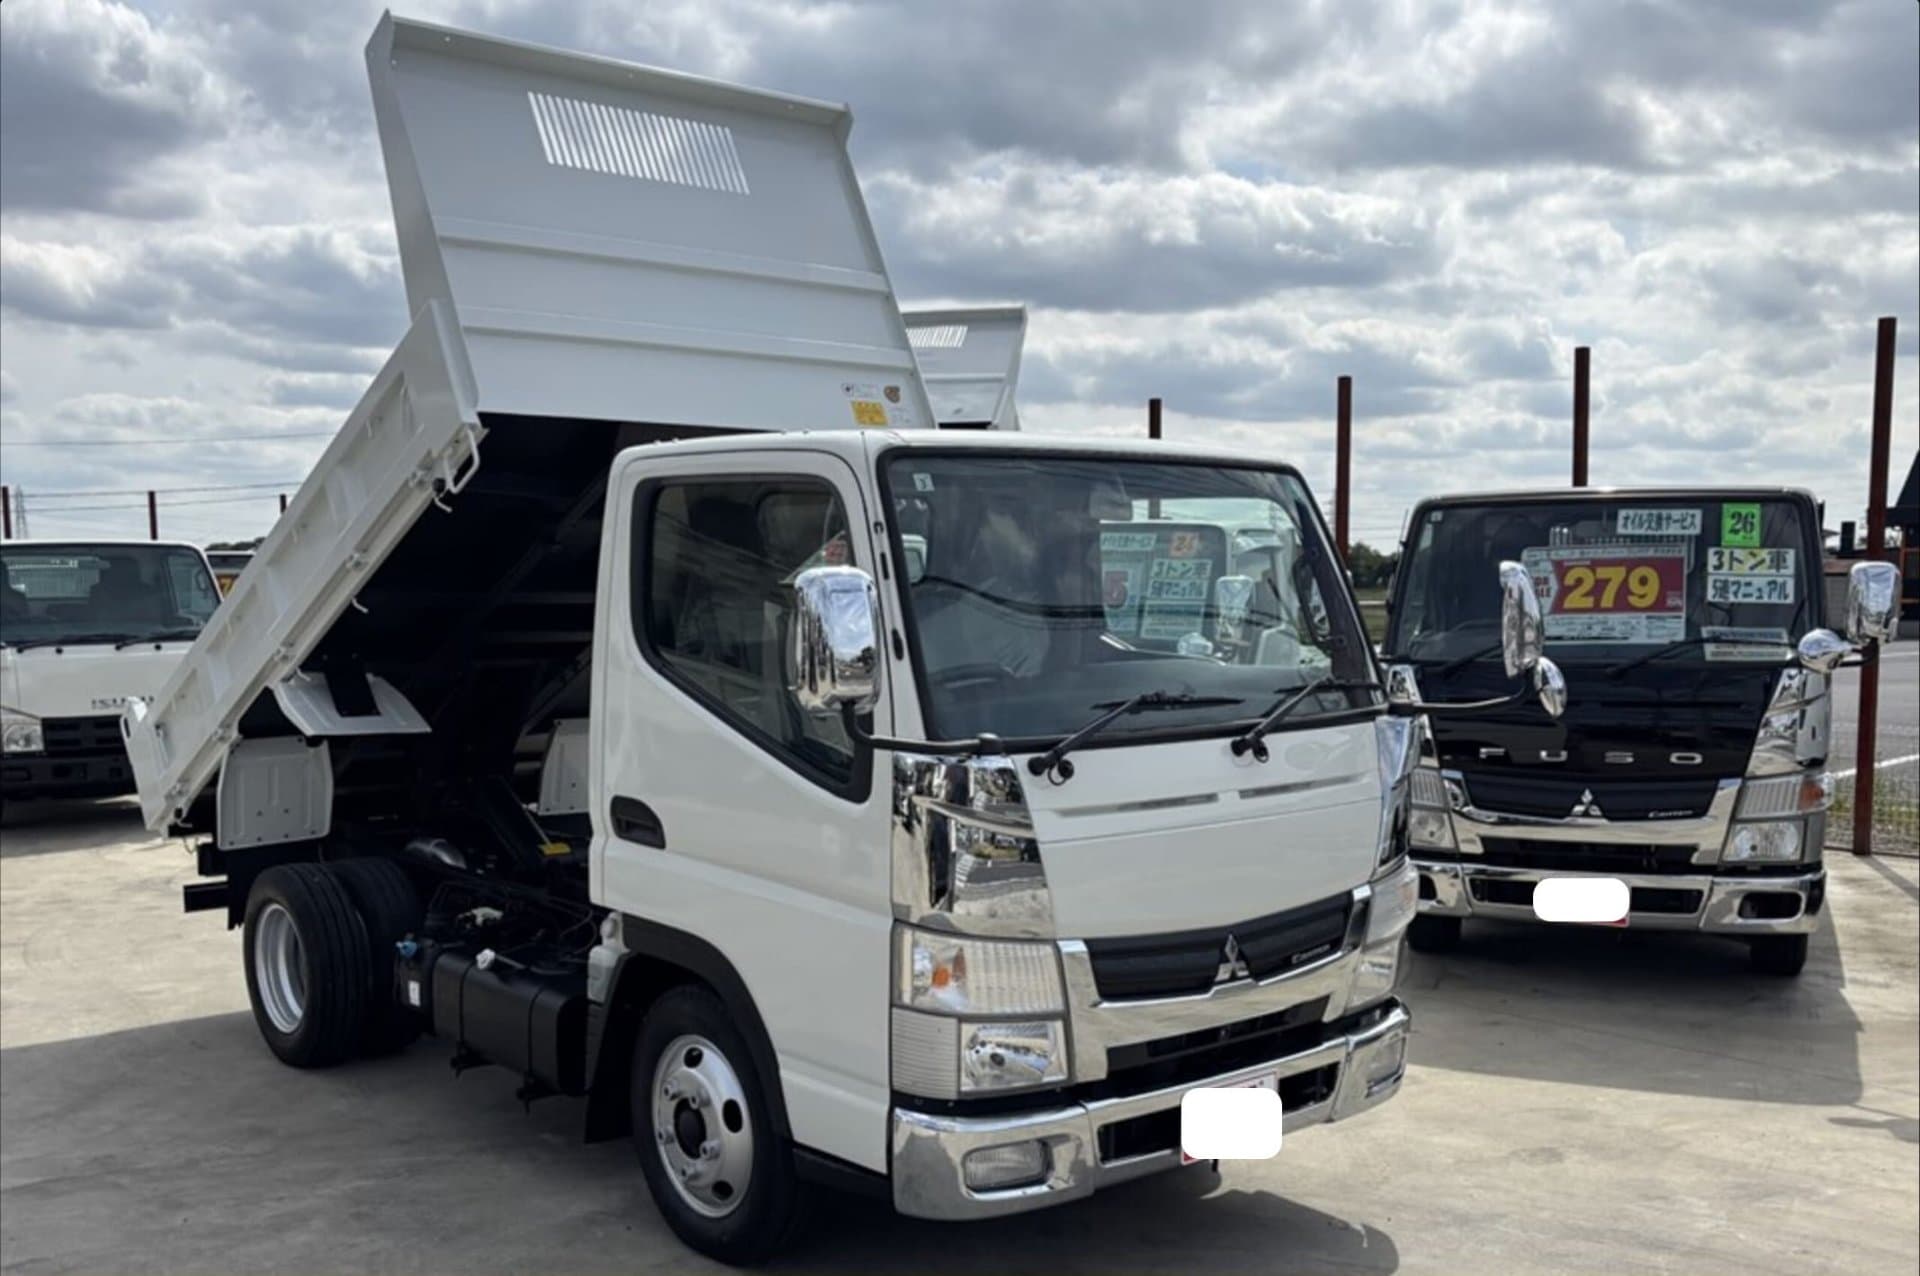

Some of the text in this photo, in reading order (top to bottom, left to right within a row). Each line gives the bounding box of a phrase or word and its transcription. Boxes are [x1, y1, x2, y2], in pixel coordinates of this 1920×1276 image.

[1729, 511, 1756, 535] 26
[1713, 550, 1789, 573] 3トン車
[1563, 566, 1660, 609] 279
[91, 696, 155, 710] ISUU
[1479, 747, 1703, 764] FUSO
